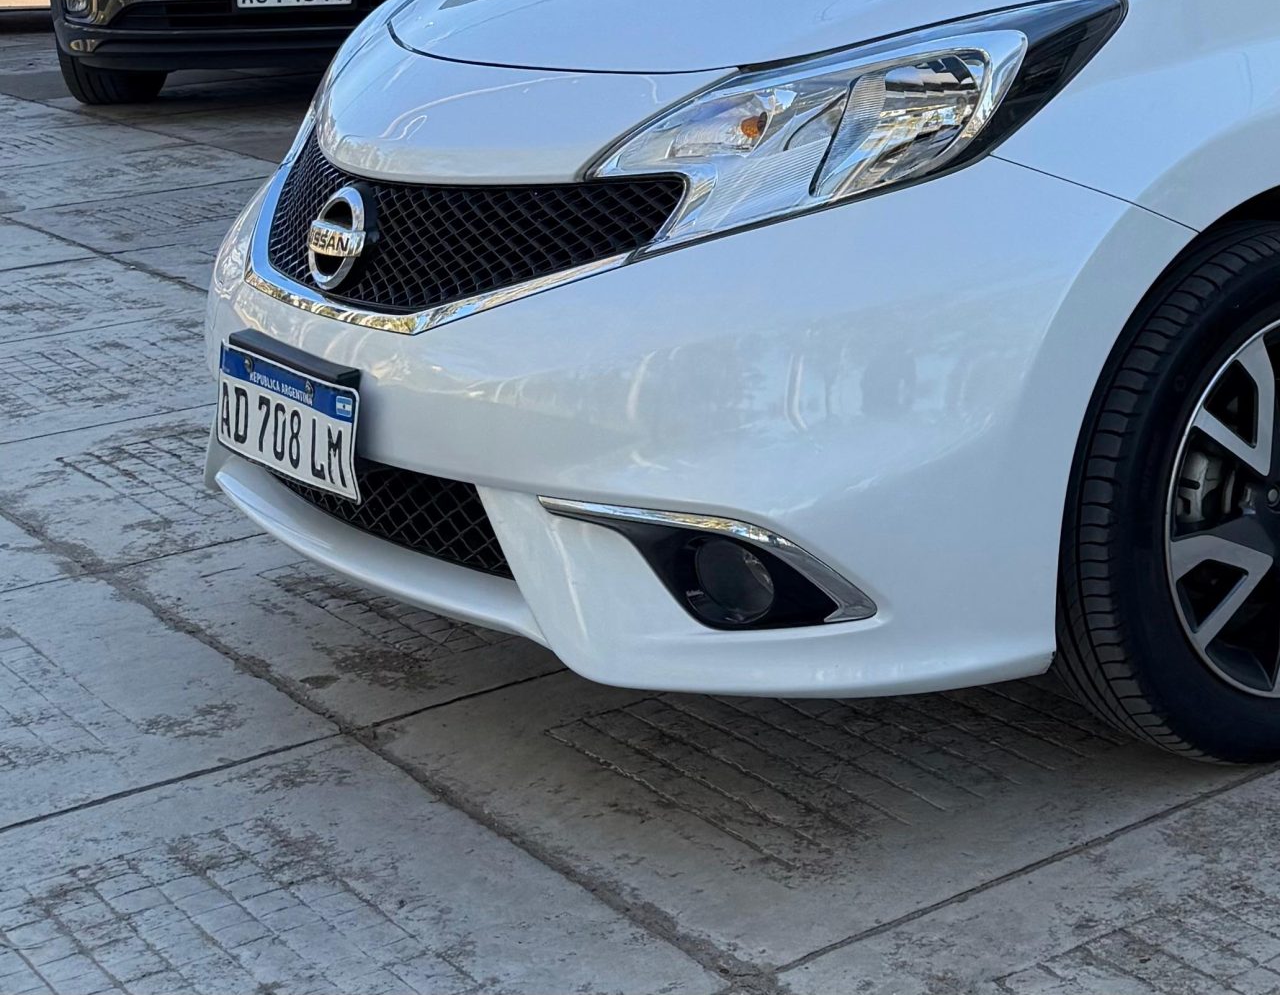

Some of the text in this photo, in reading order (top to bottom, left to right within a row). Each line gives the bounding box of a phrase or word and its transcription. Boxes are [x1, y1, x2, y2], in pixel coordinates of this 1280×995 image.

[220, 381, 348, 489] AD 708 LM
